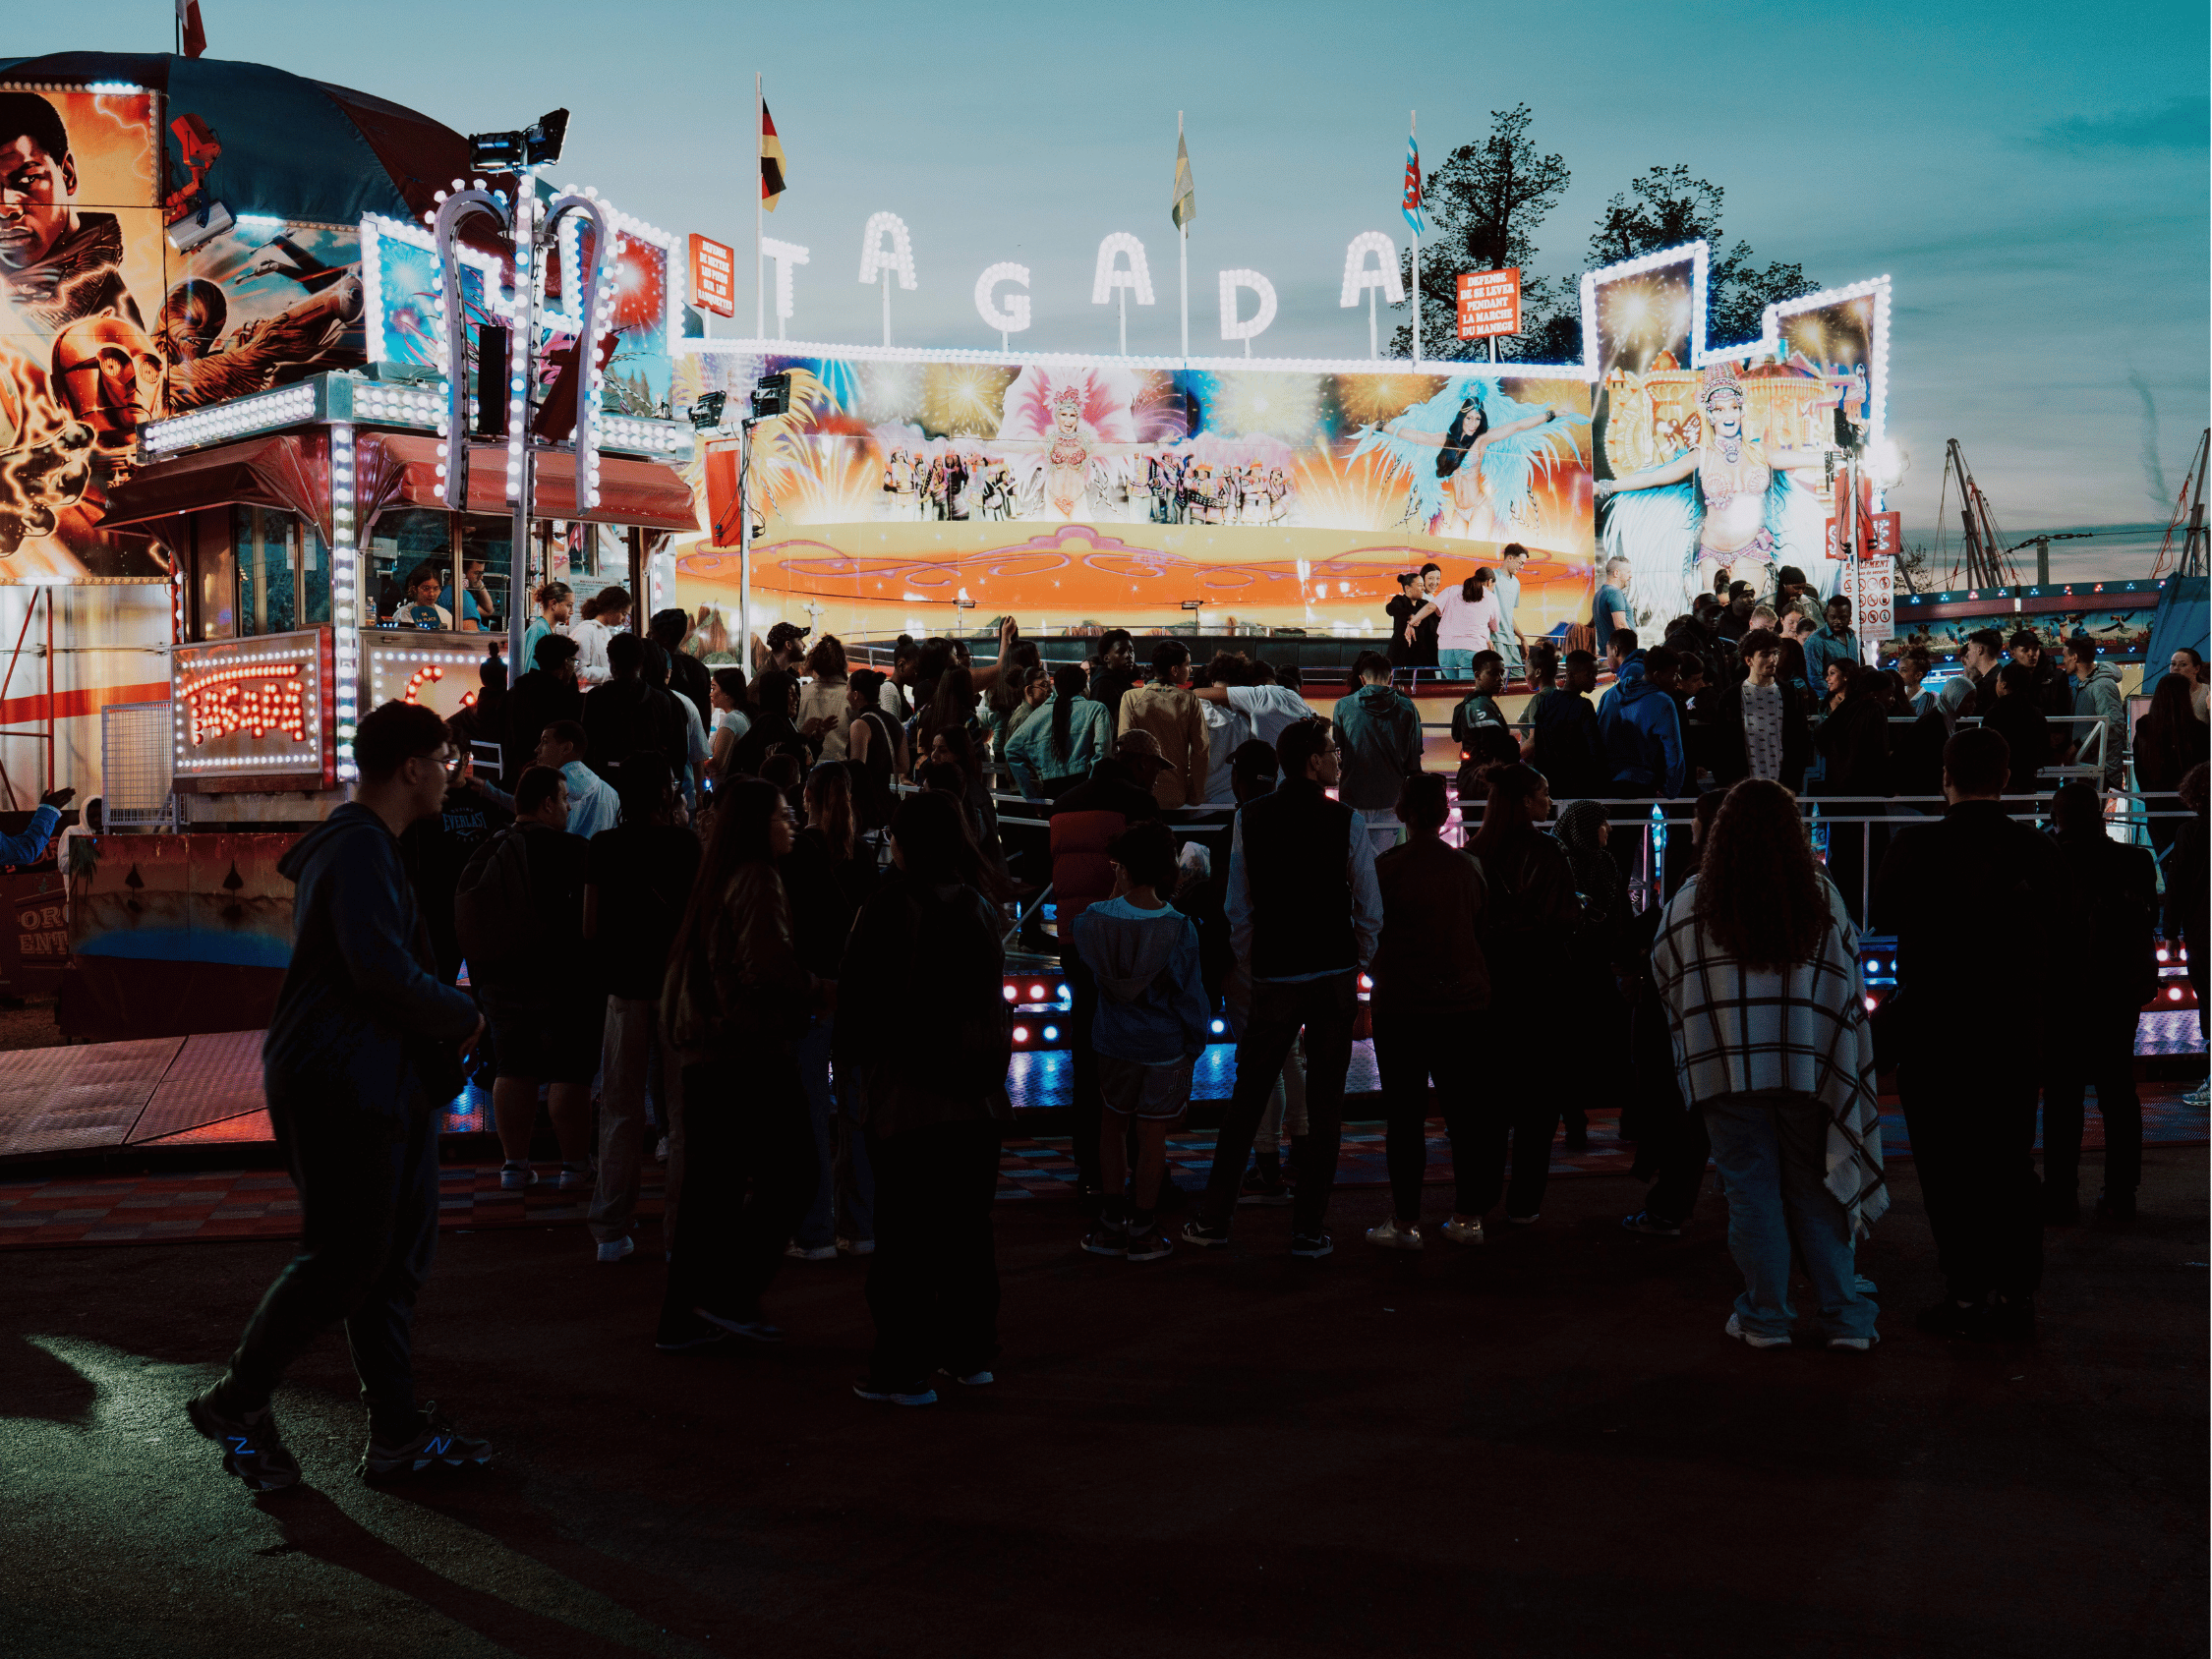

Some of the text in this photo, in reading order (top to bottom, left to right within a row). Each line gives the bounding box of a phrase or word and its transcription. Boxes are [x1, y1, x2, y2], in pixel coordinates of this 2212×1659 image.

[761, 211, 1405, 340] TAGADA
[1467, 272, 1507, 287] DEFENSE
[1460, 283, 1515, 300] DE SE LEVER
[1467, 296, 1509, 312] PENDANT
[1462, 308, 1513, 324] LA MARCHE
[1462, 320, 1514, 337] DU MANEGE
[441, 811, 489, 832] EVERLAST
